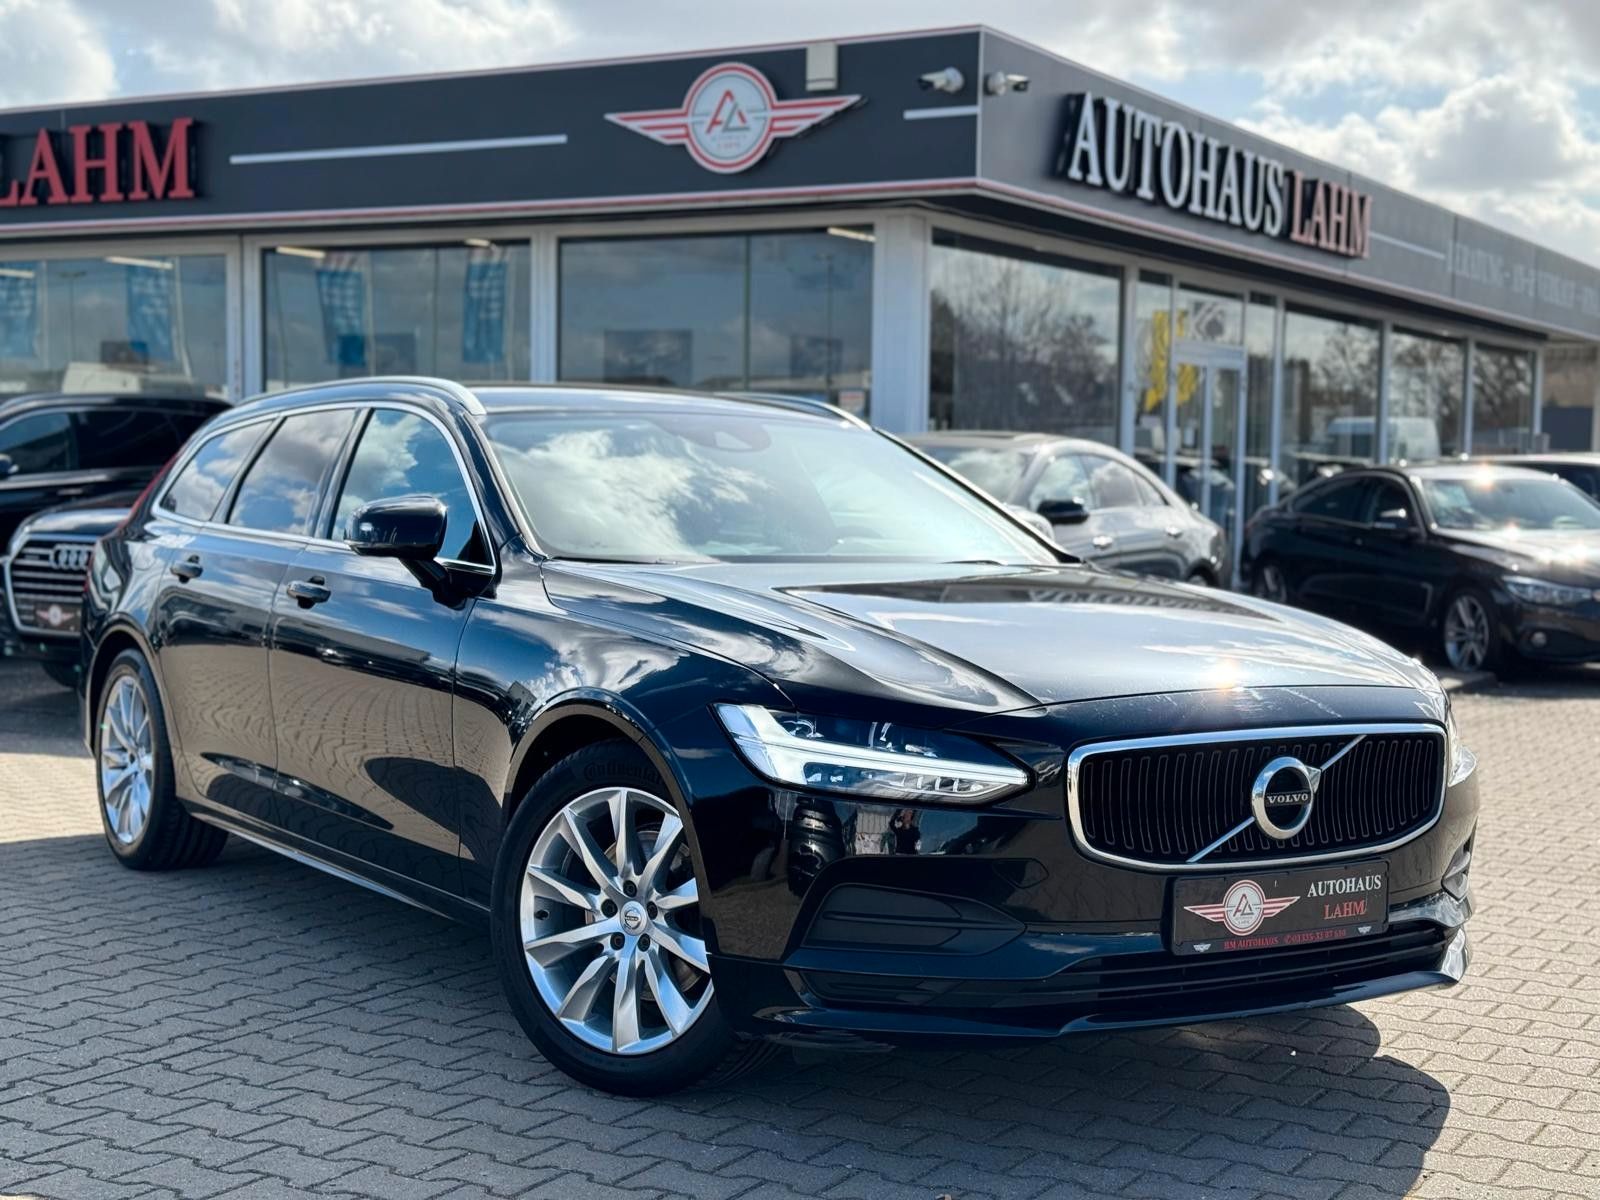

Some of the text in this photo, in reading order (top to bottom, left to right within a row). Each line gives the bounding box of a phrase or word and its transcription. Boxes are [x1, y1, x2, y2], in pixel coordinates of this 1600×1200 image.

[1068, 91, 1373, 259] AUTOHAUS LAHM
[1267, 793, 1309, 804] VOLVO
[1307, 875, 1382, 897] AUTOHAUS
[1324, 899, 1366, 919] LAHM
